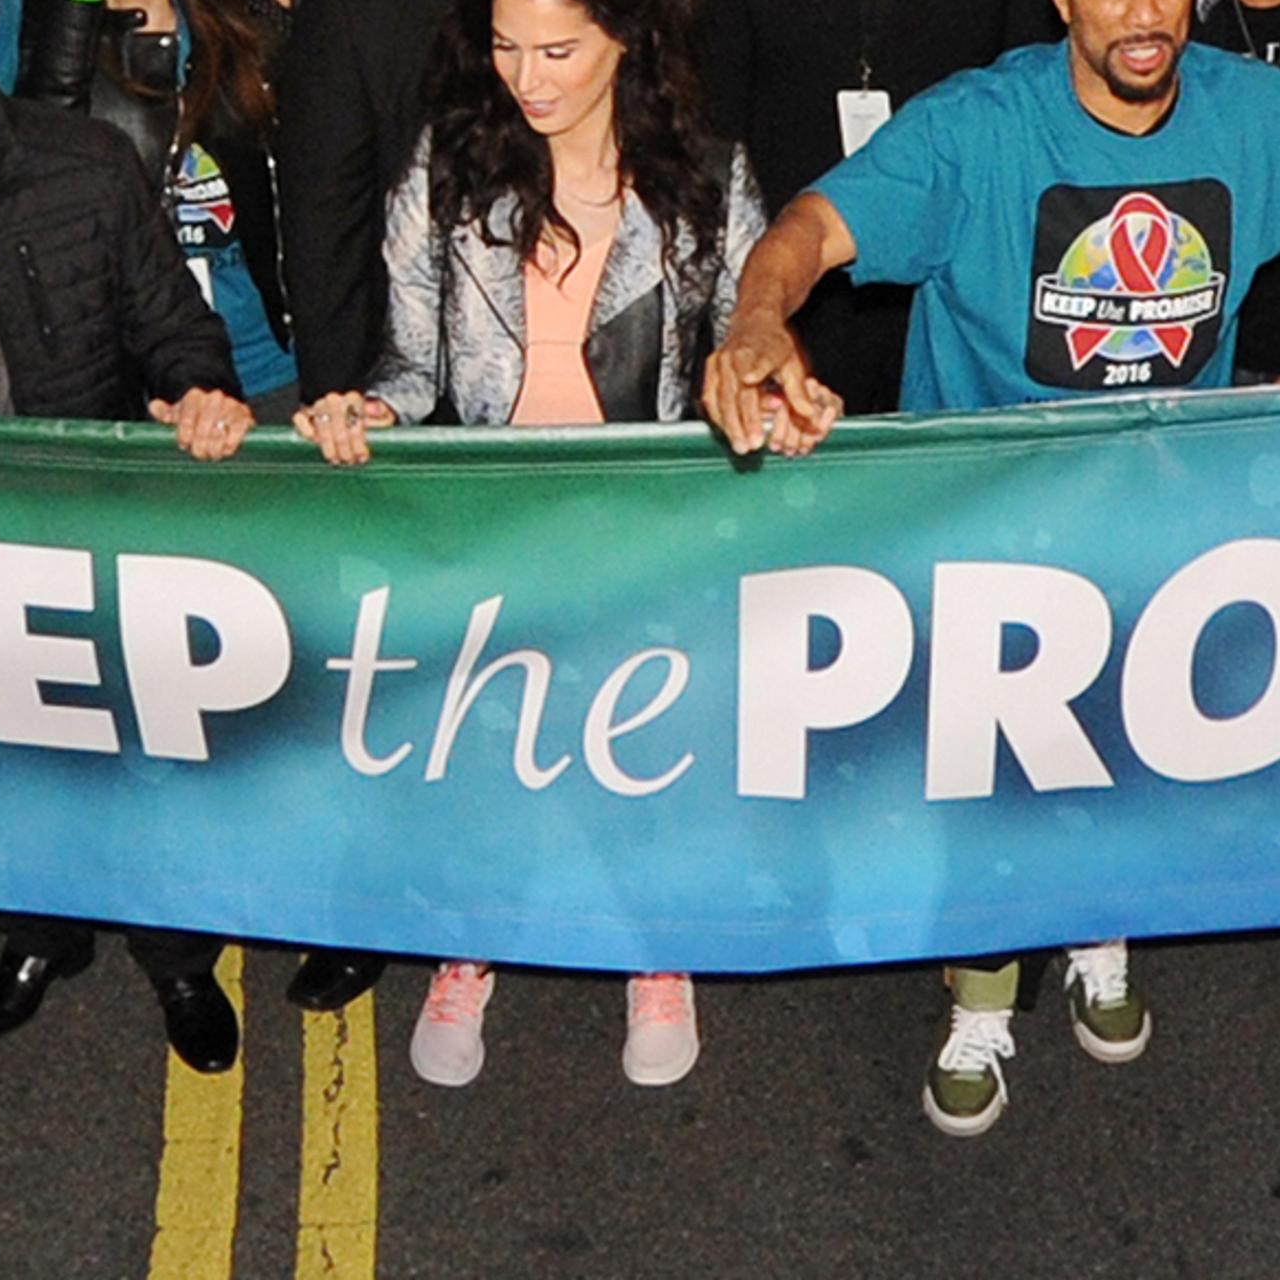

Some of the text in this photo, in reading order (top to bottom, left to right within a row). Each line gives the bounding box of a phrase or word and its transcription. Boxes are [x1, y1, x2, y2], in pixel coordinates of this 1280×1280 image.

[1042, 290, 1095, 316] KEEP
[1128, 289, 1215, 323] PROMISE
[1102, 362, 1153, 386] 2016
[324, 585, 696, 798] the
